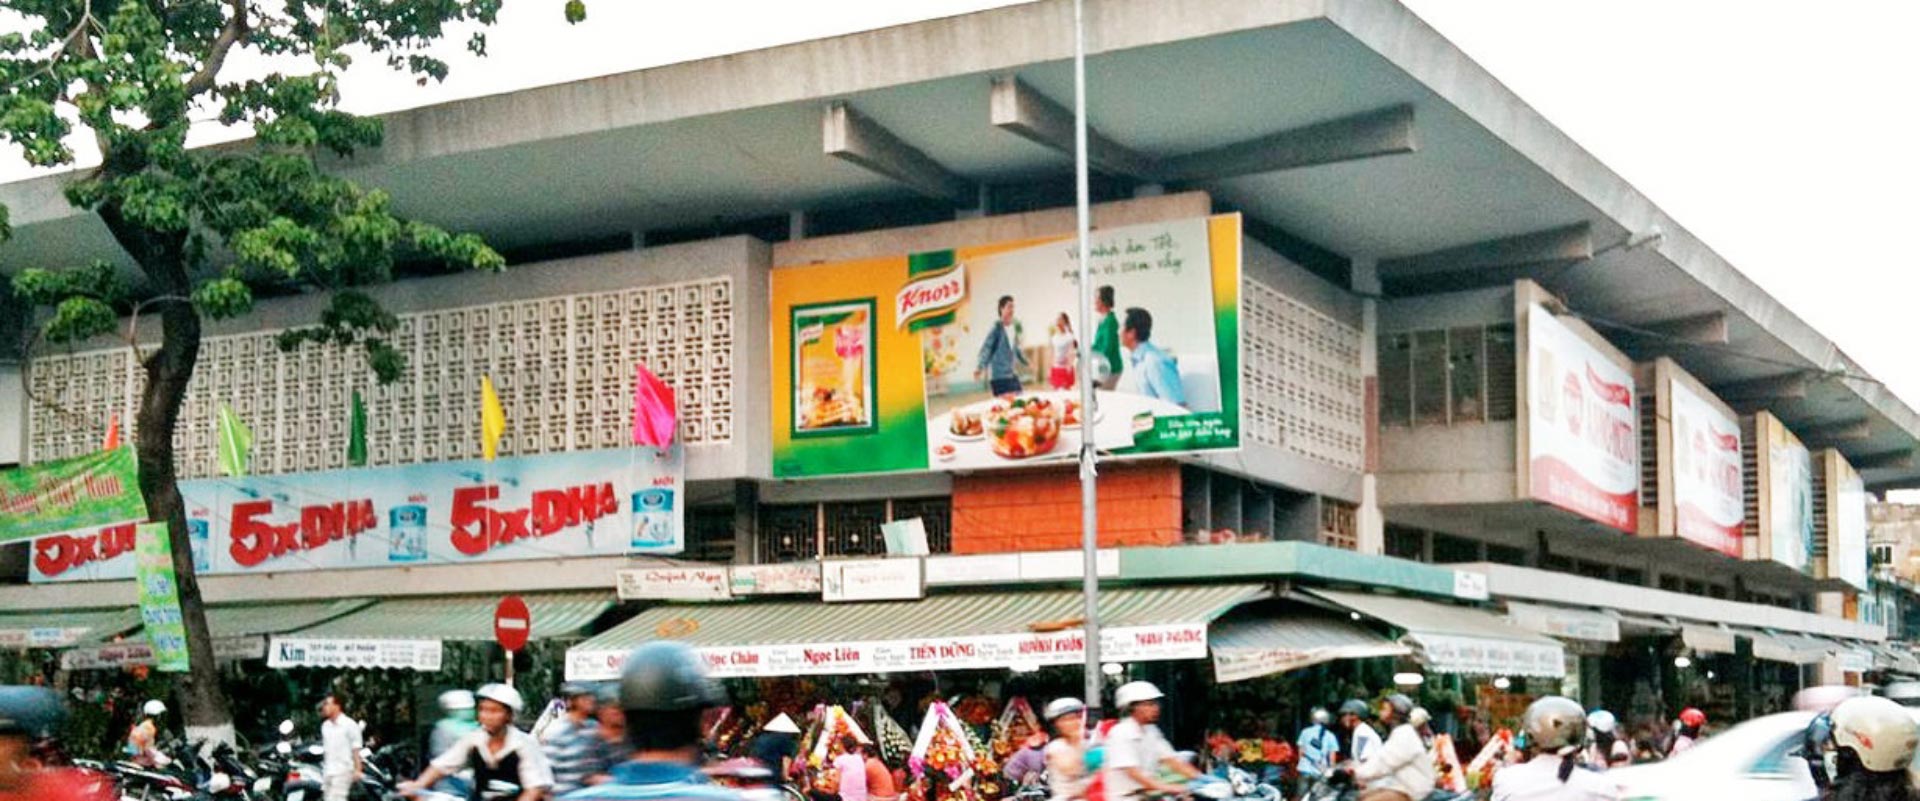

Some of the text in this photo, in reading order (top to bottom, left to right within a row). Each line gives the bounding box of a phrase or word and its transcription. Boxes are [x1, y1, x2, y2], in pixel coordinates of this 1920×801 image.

[901, 280, 959, 314] Knorr
[450, 482, 620, 556] 5xDHA
[230, 499, 378, 567] 5xDHA
[280, 643, 306, 662] Kim
[803, 648, 832, 666] Ngọc
[834, 646, 860, 662] Liên
[940, 640, 976, 659] DŨNG
